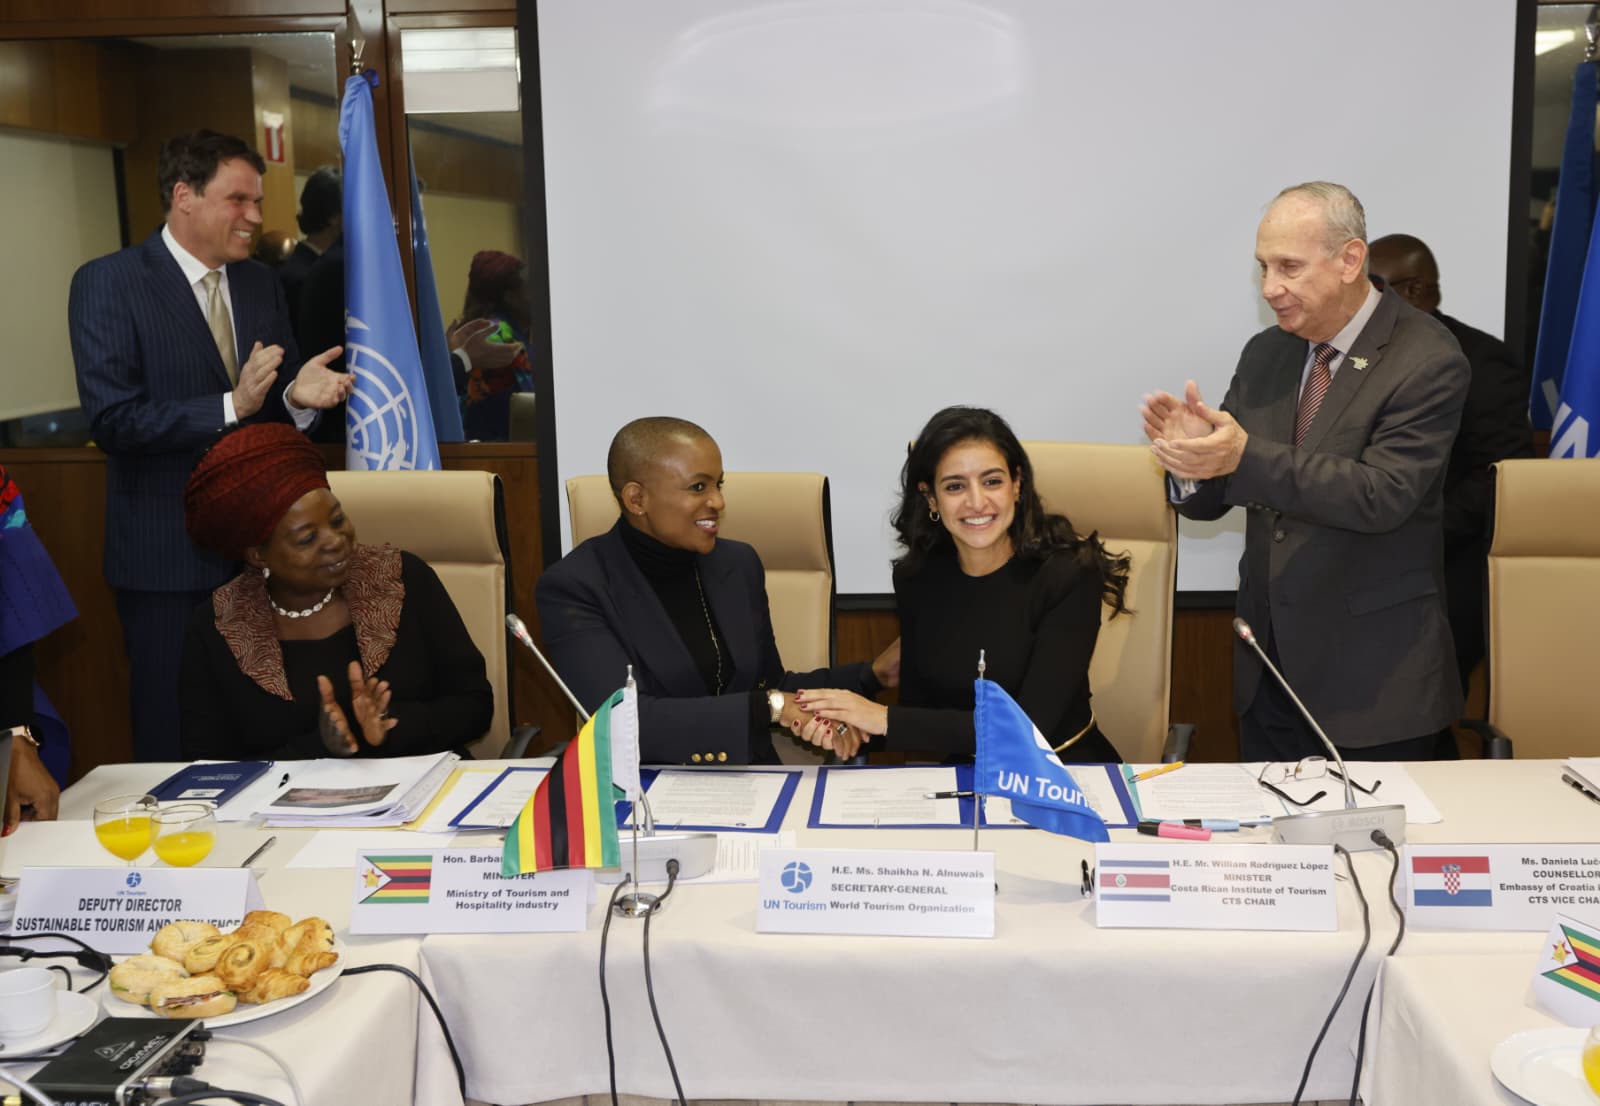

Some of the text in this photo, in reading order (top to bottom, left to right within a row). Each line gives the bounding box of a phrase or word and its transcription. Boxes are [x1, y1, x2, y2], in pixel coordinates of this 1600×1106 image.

[998, 770, 1030, 795] UN
[443, 855, 466, 864] Hon.
[1172, 859, 1192, 867] H.E.
[1195, 860, 1209, 868] Mr.
[1211, 860, 1247, 869] William
[1521, 857, 1538, 865] Ms.
[1541, 857, 1578, 865] Daniela
[831, 866, 985, 879] H.E. Ms. Shaikha N. Alnuwais
[1224, 873, 1272, 882] MINISTER
[1533, 870, 1600, 878] COUNSELLOR
[831, 883, 948, 895] SECRETARY-GENERAL
[1170, 884, 1328, 896] Costa Rican Institute of Tourism
[1499, 883, 1543, 893] Embassy
[1545, 883, 1556, 891] of
[1559, 883, 1595, 891] Croatia
[446, 889, 569, 900] Ministry of Tourism and
[78, 898, 182, 912] DEPUTY DIRECTOR
[1222, 897, 1277, 907] CTS CHAIR
[1528, 896, 1549, 904] CTS
[1551, 896, 1576, 904] VICE
[455, 901, 559, 911] Hospitality industry
[763, 899, 827, 912] UN Tourism
[830, 901, 976, 914] World Tourism Organization
[15, 918, 91, 932] SUSTAINABLE
[96, 918, 145, 932] TOURISM
[147, 919, 171, 932] AND
